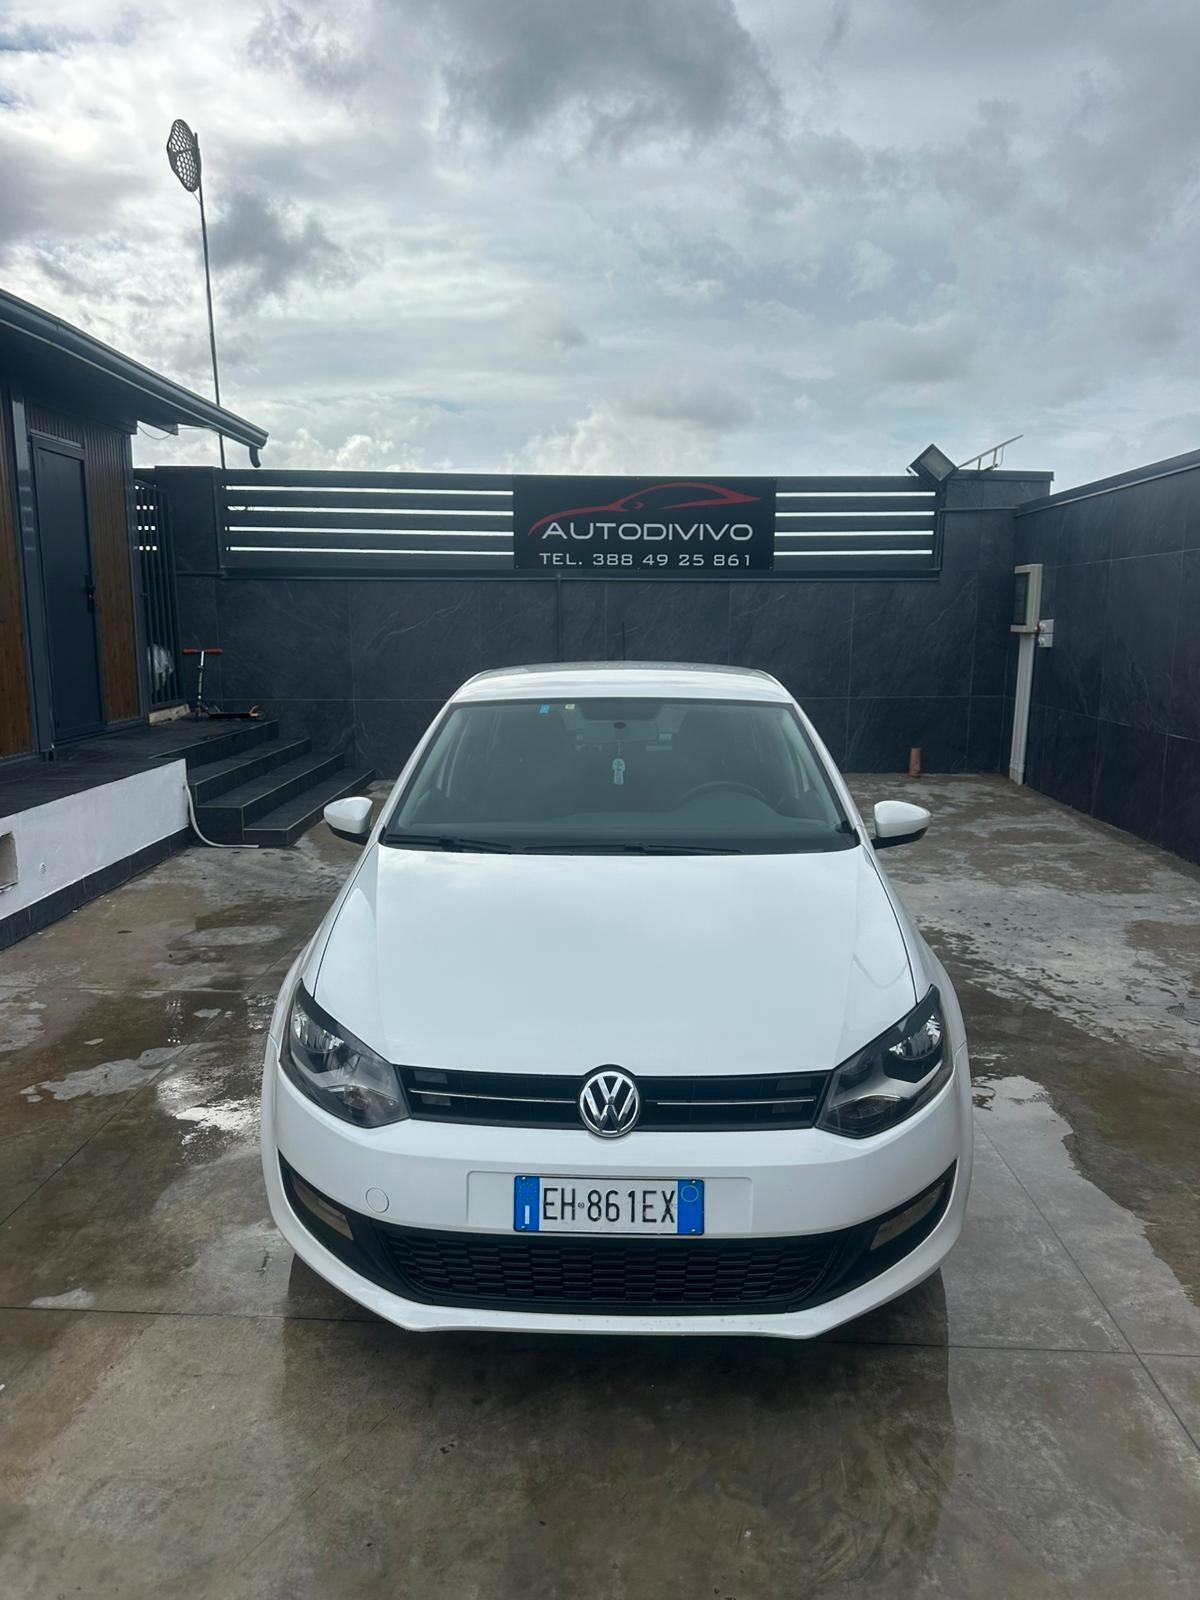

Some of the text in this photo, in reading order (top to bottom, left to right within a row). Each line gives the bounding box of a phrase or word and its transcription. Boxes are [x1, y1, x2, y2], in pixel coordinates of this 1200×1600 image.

[541, 521, 753, 541] AUTODIVIVO
[539, 552, 750, 567] TEL. 388 49 25 861
